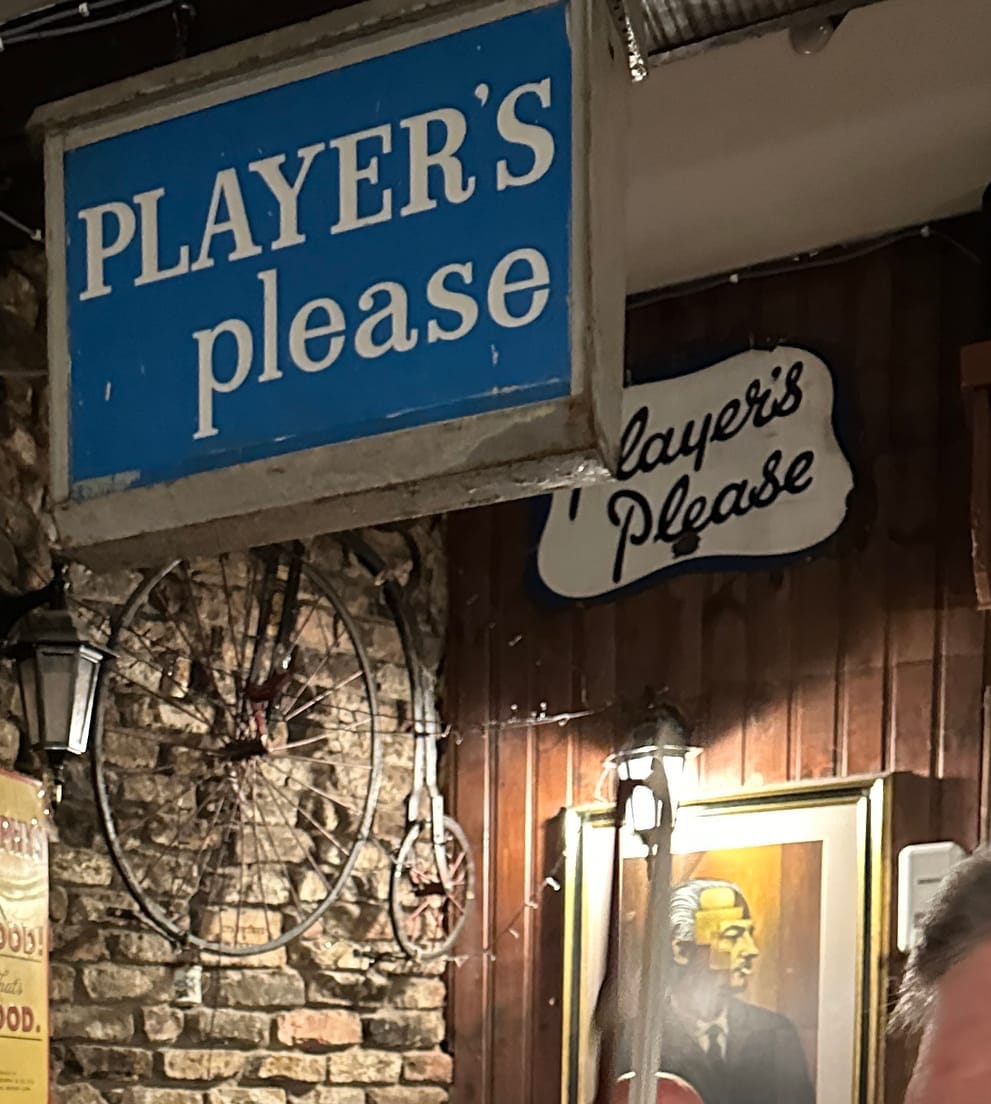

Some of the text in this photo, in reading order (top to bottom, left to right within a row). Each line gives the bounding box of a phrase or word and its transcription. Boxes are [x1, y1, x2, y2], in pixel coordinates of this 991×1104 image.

[78, 78, 555, 301] PLAYER'S
[193, 247, 551, 440] please
[570, 359, 804, 520] layer's
[607, 449, 814, 584] Please
